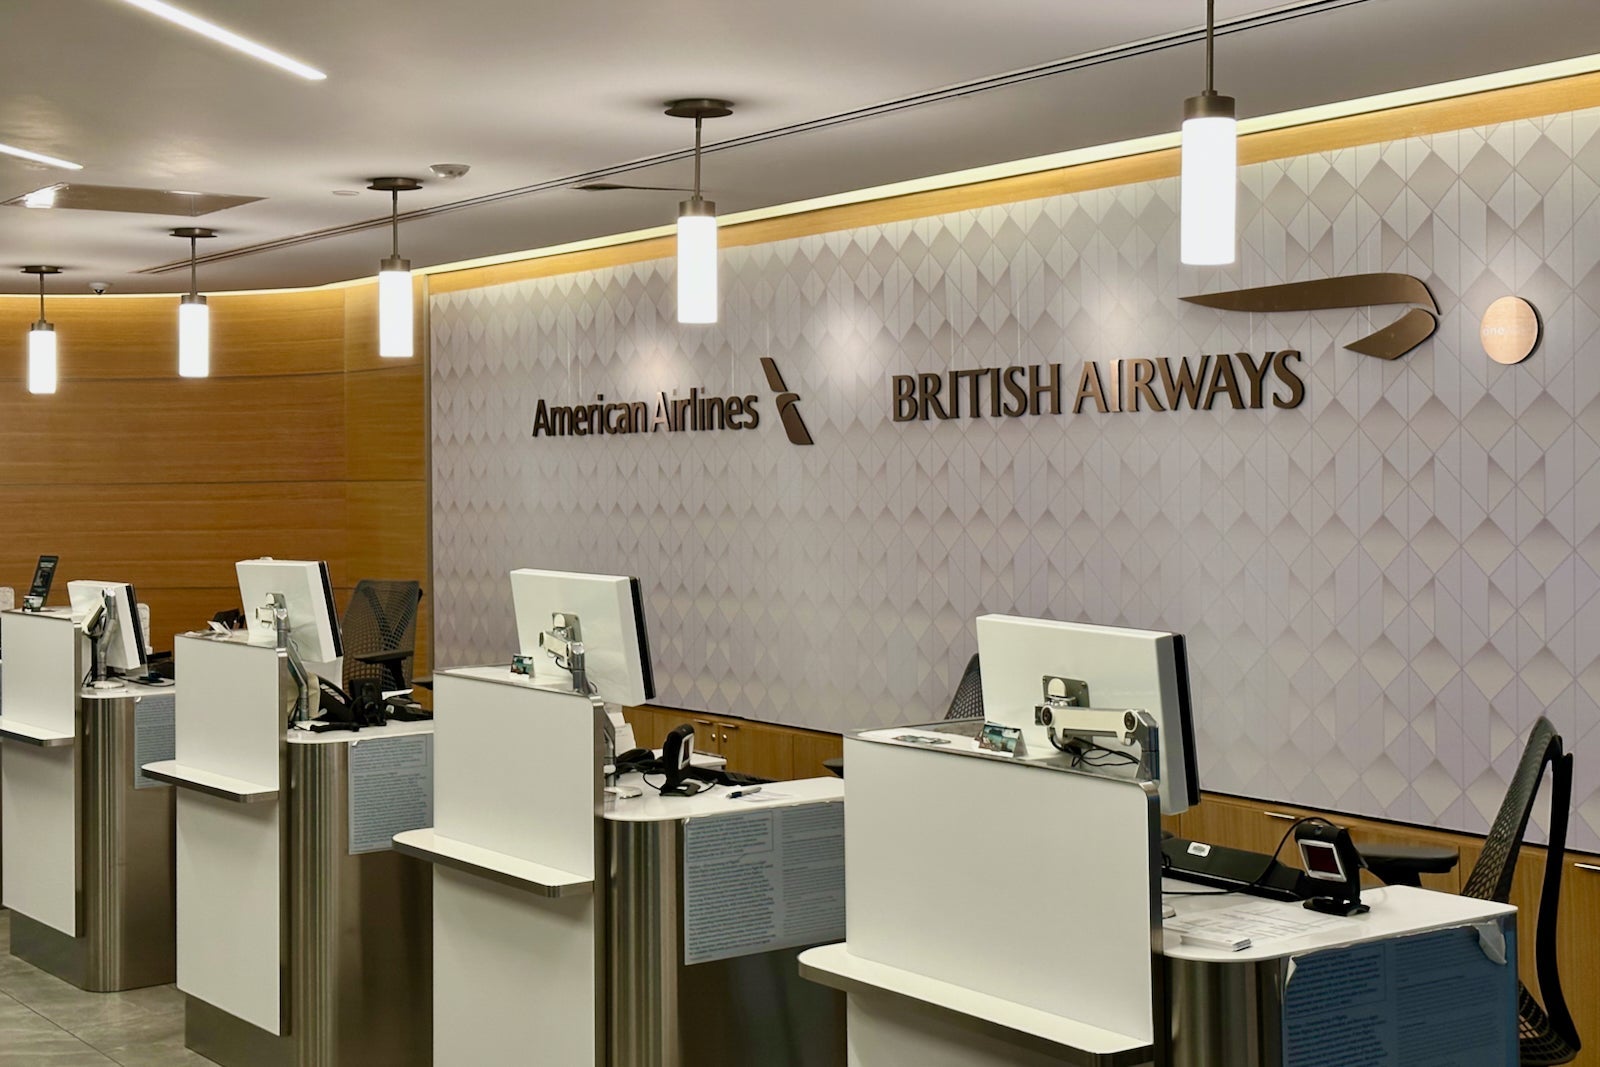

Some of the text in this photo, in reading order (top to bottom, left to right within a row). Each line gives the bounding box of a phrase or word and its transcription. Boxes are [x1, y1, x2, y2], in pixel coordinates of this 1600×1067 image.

[532, 387, 760, 437] American Airlines
[891, 350, 1305, 422] BRITISH AIRWAYS
